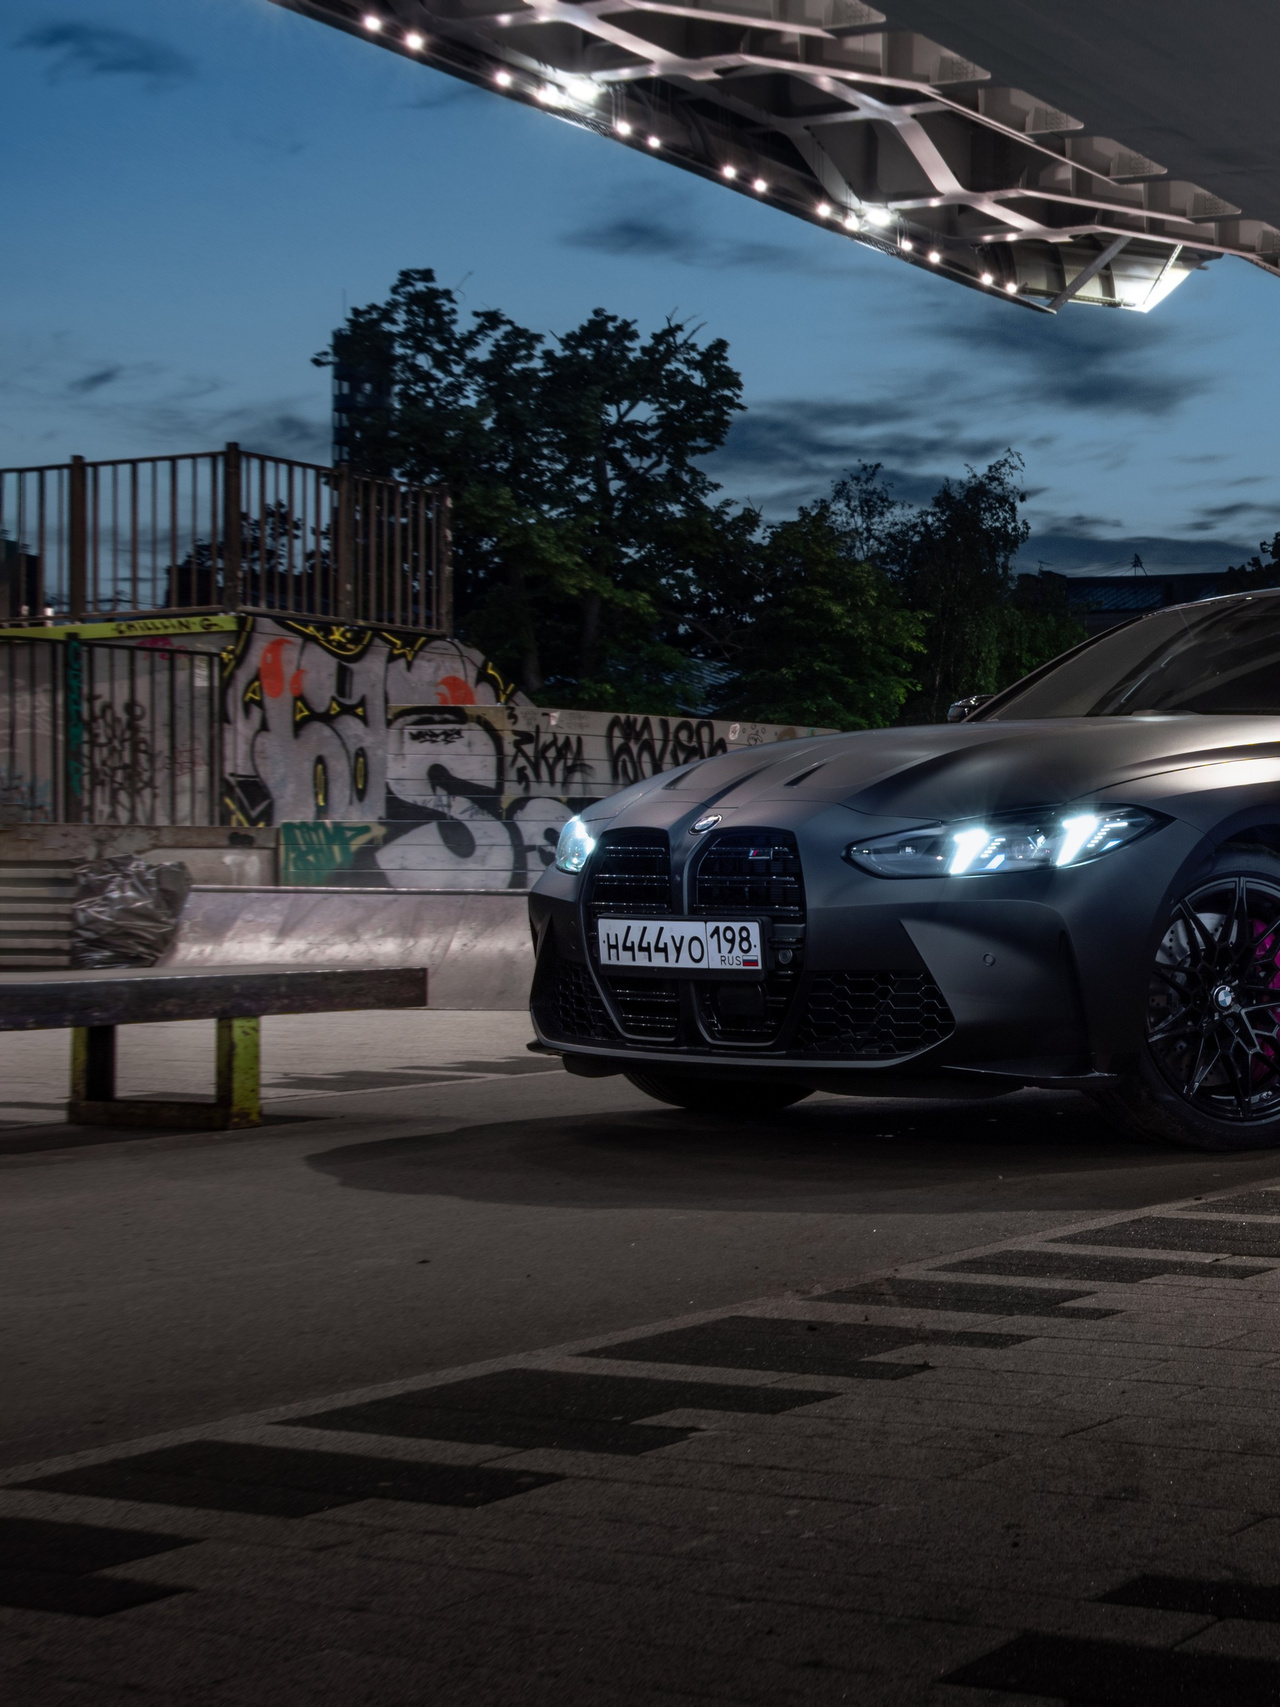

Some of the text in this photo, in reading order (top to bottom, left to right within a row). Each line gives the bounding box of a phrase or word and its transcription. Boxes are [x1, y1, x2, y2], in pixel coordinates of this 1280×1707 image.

[606, 925, 752, 963] Н444УО 198
[721, 955, 742, 966] RUS
